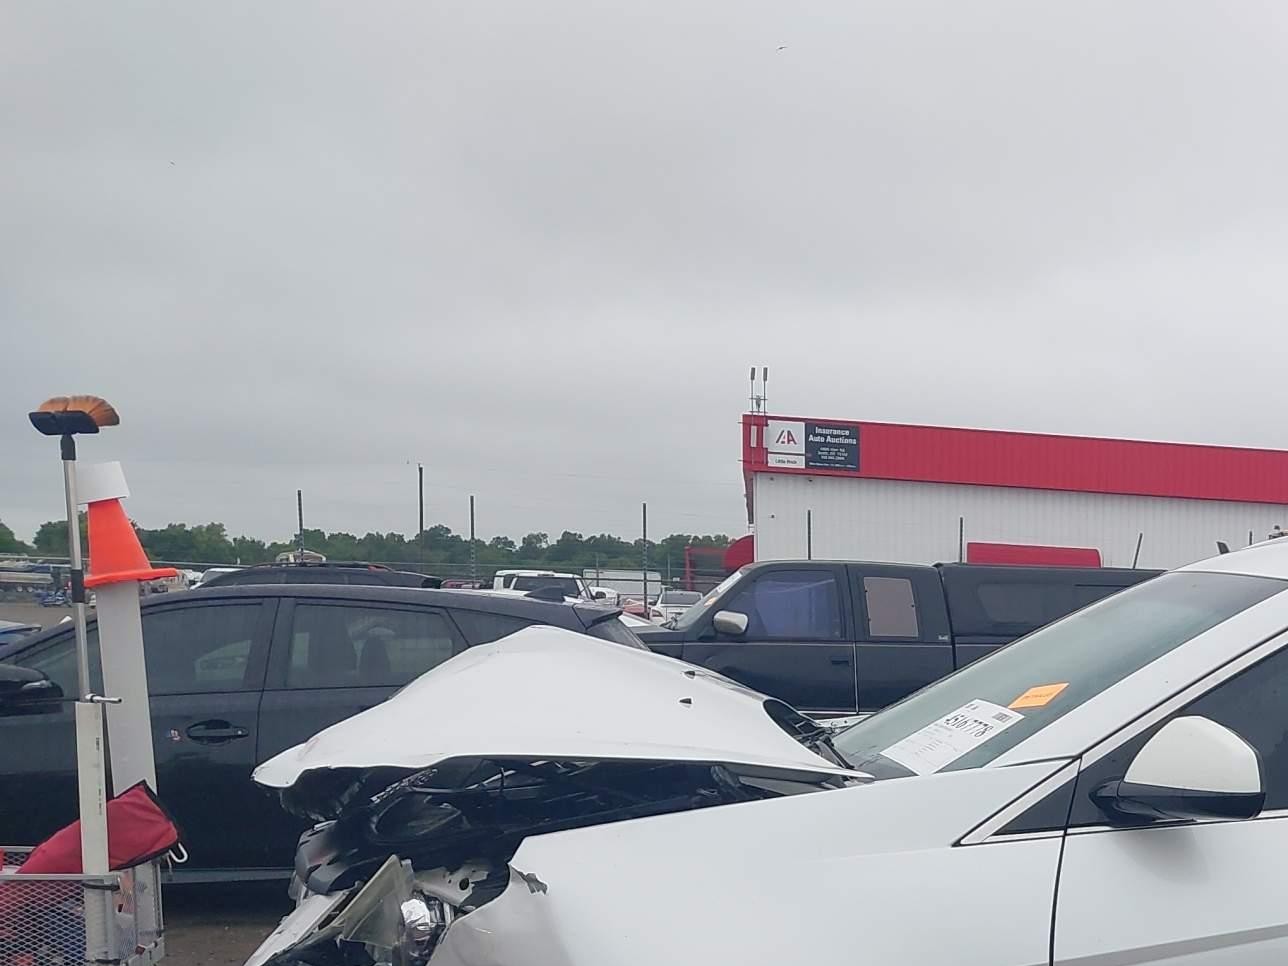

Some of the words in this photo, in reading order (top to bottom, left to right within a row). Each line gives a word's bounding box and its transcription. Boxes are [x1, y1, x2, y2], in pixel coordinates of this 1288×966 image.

[815, 426, 850, 436] Insurance
[808, 434, 825, 443] Auto
[826, 435, 857, 445] Auctions
